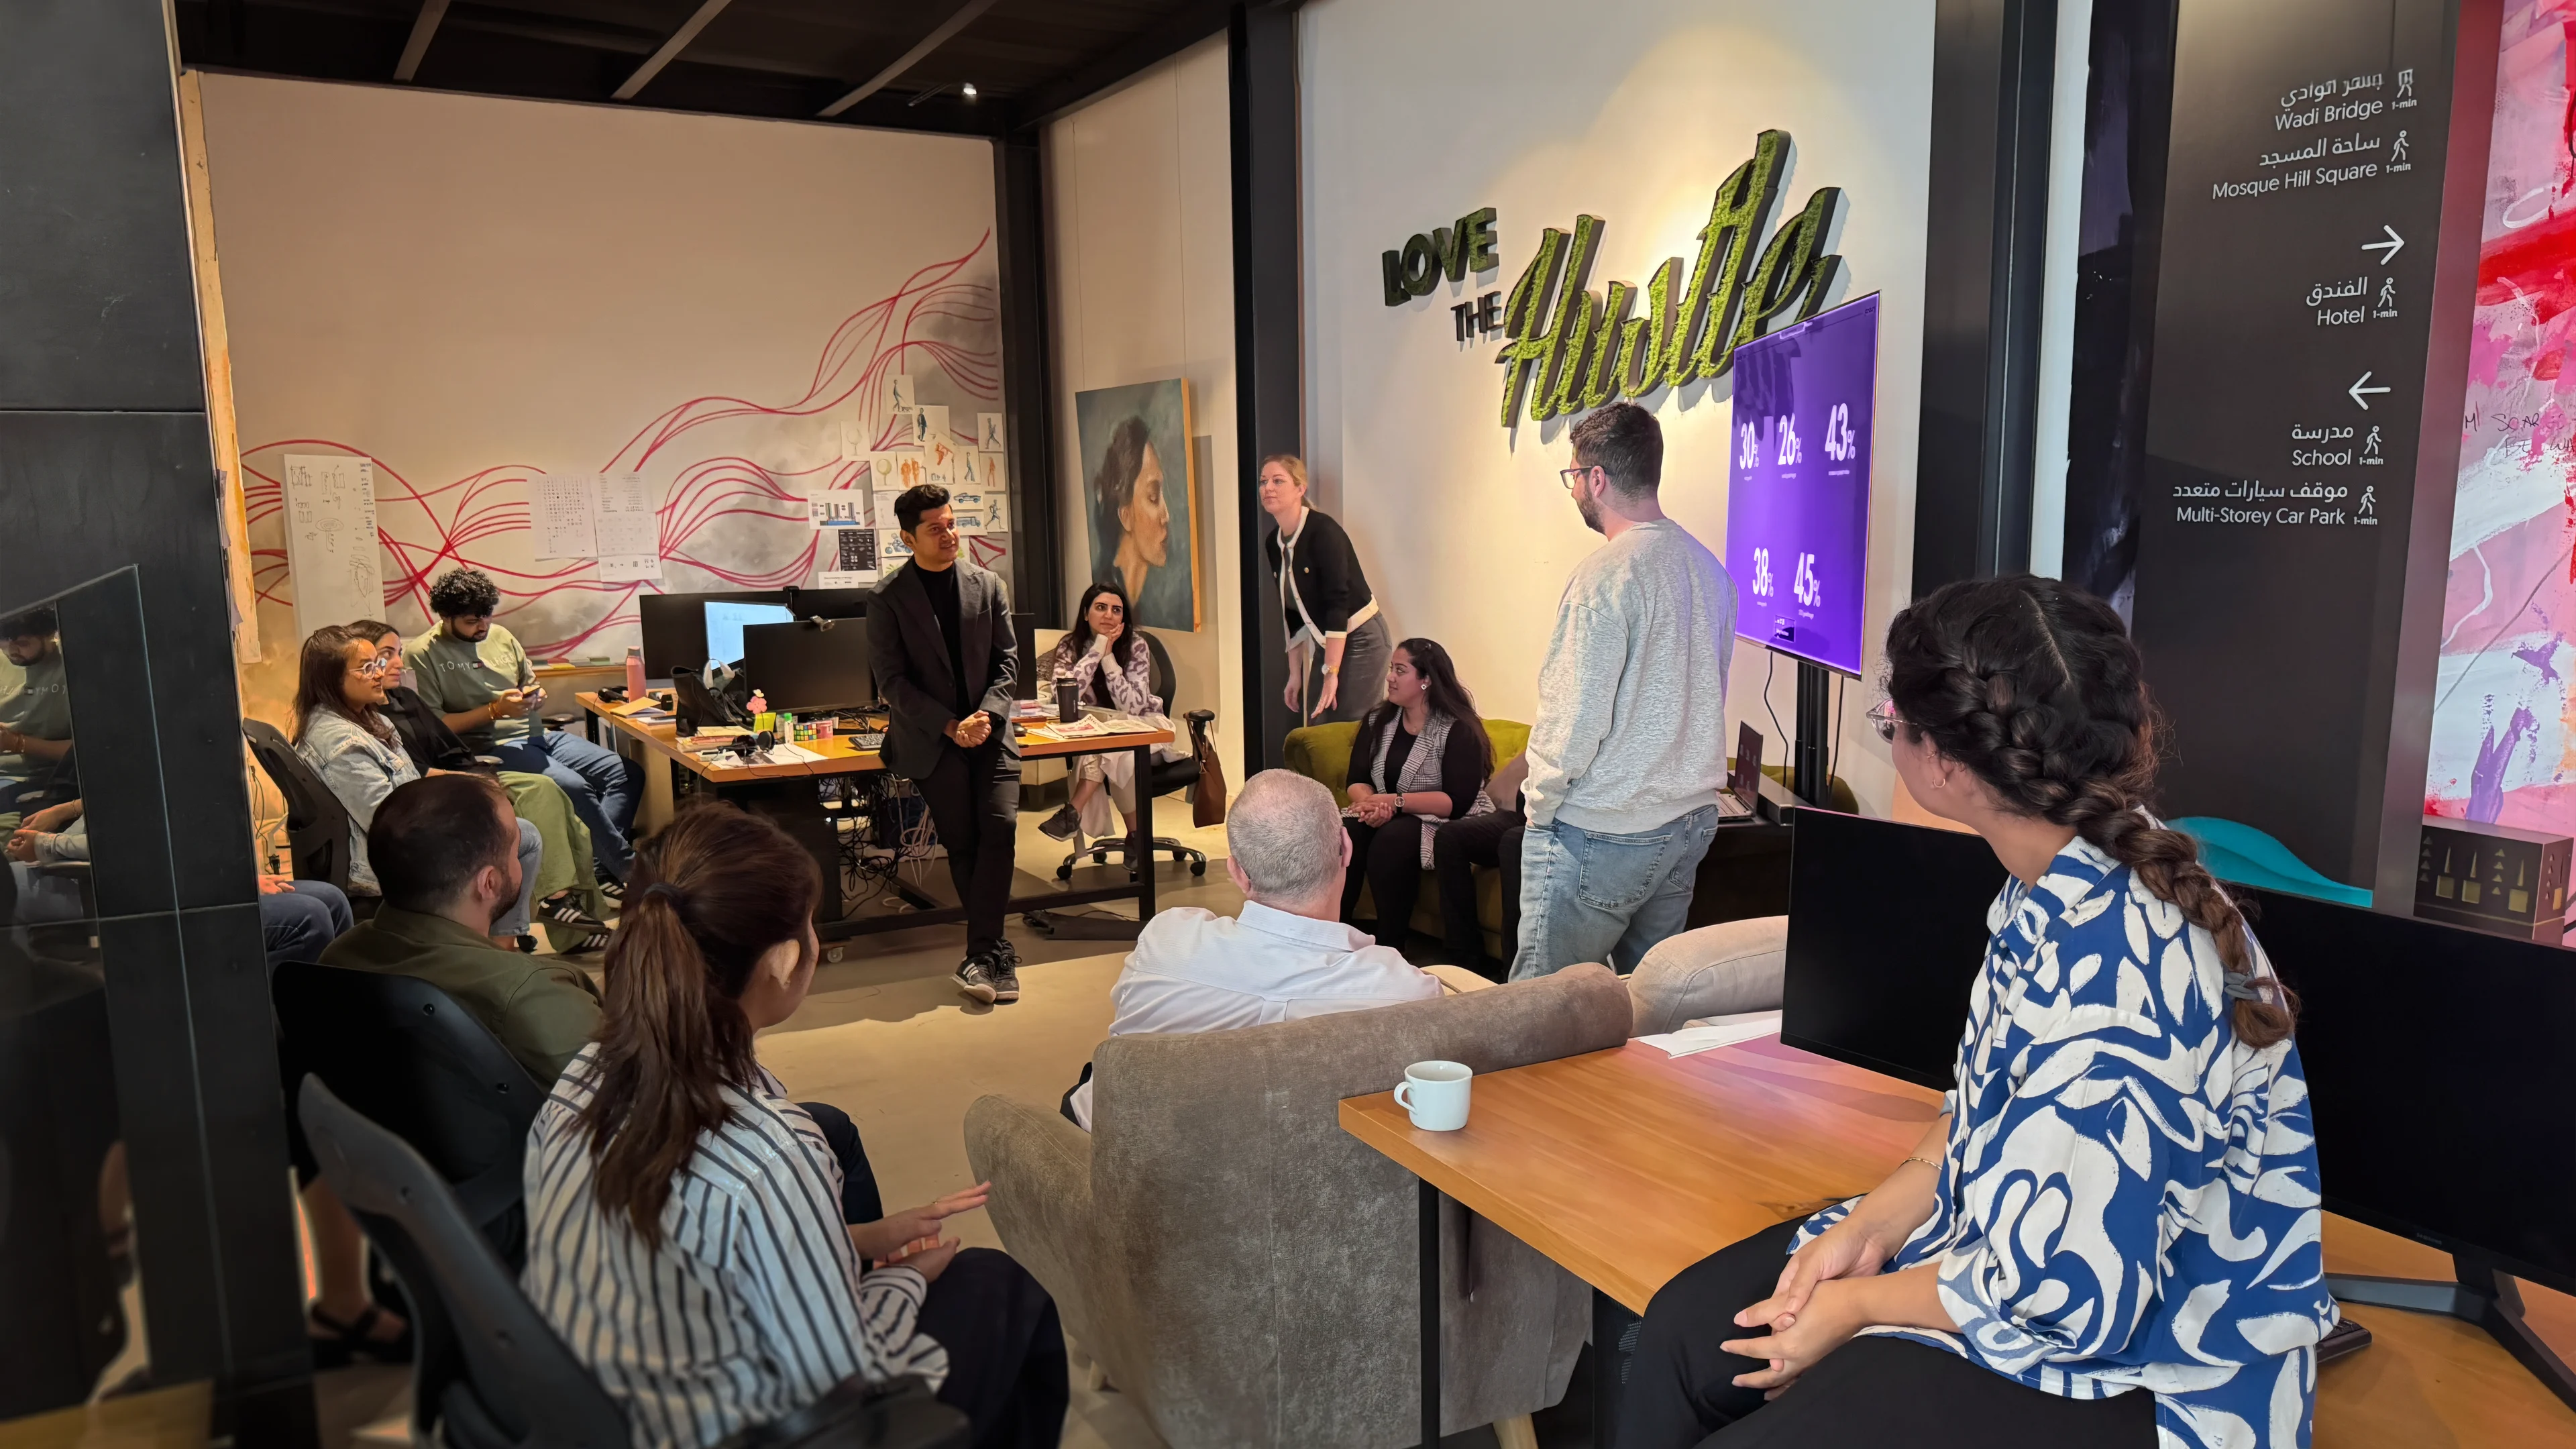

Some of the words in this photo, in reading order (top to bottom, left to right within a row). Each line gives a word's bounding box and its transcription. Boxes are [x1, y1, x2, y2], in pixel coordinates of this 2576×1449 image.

[2392, 98, 2418, 110] 1-min
[2275, 107, 2320, 131] Wadi
[2324, 100, 2383, 123] Bridge
[2259, 137, 2327, 169] المسجد
[2332, 132, 2380, 155] ساحة
[2385, 162, 2412, 174] 1-min
[2212, 178, 2280, 200] Mosque
[2284, 169, 2311, 189] Hill
[2315, 163, 2378, 186] Square
[1382, 207, 1499, 307] LOVE
[2306, 276, 2368, 307] الفندق
[1450, 290, 1503, 342] THE
[2317, 305, 2365, 326] Hotel
[2372, 308, 2398, 319] 1-min
[1778, 413, 1803, 466] 26%
[1825, 402, 1856, 462] 43%
[2292, 423, 2354, 444] مدرسة
[2292, 448, 2352, 466] School
[2359, 456, 2384, 466] 1-min
[2172, 482, 2220, 498] متعدد
[2224, 480, 2286, 502] سيارات
[2290, 482, 2348, 503] موقف
[2176, 506, 2272, 527] Multi-Storey
[2275, 507, 2305, 524] Car
[2309, 507, 2346, 525] Park
[2353, 516, 2378, 525] 1-min
[1752, 547, 1774, 597] 38%
[1793, 551, 1821, 607] 45%
